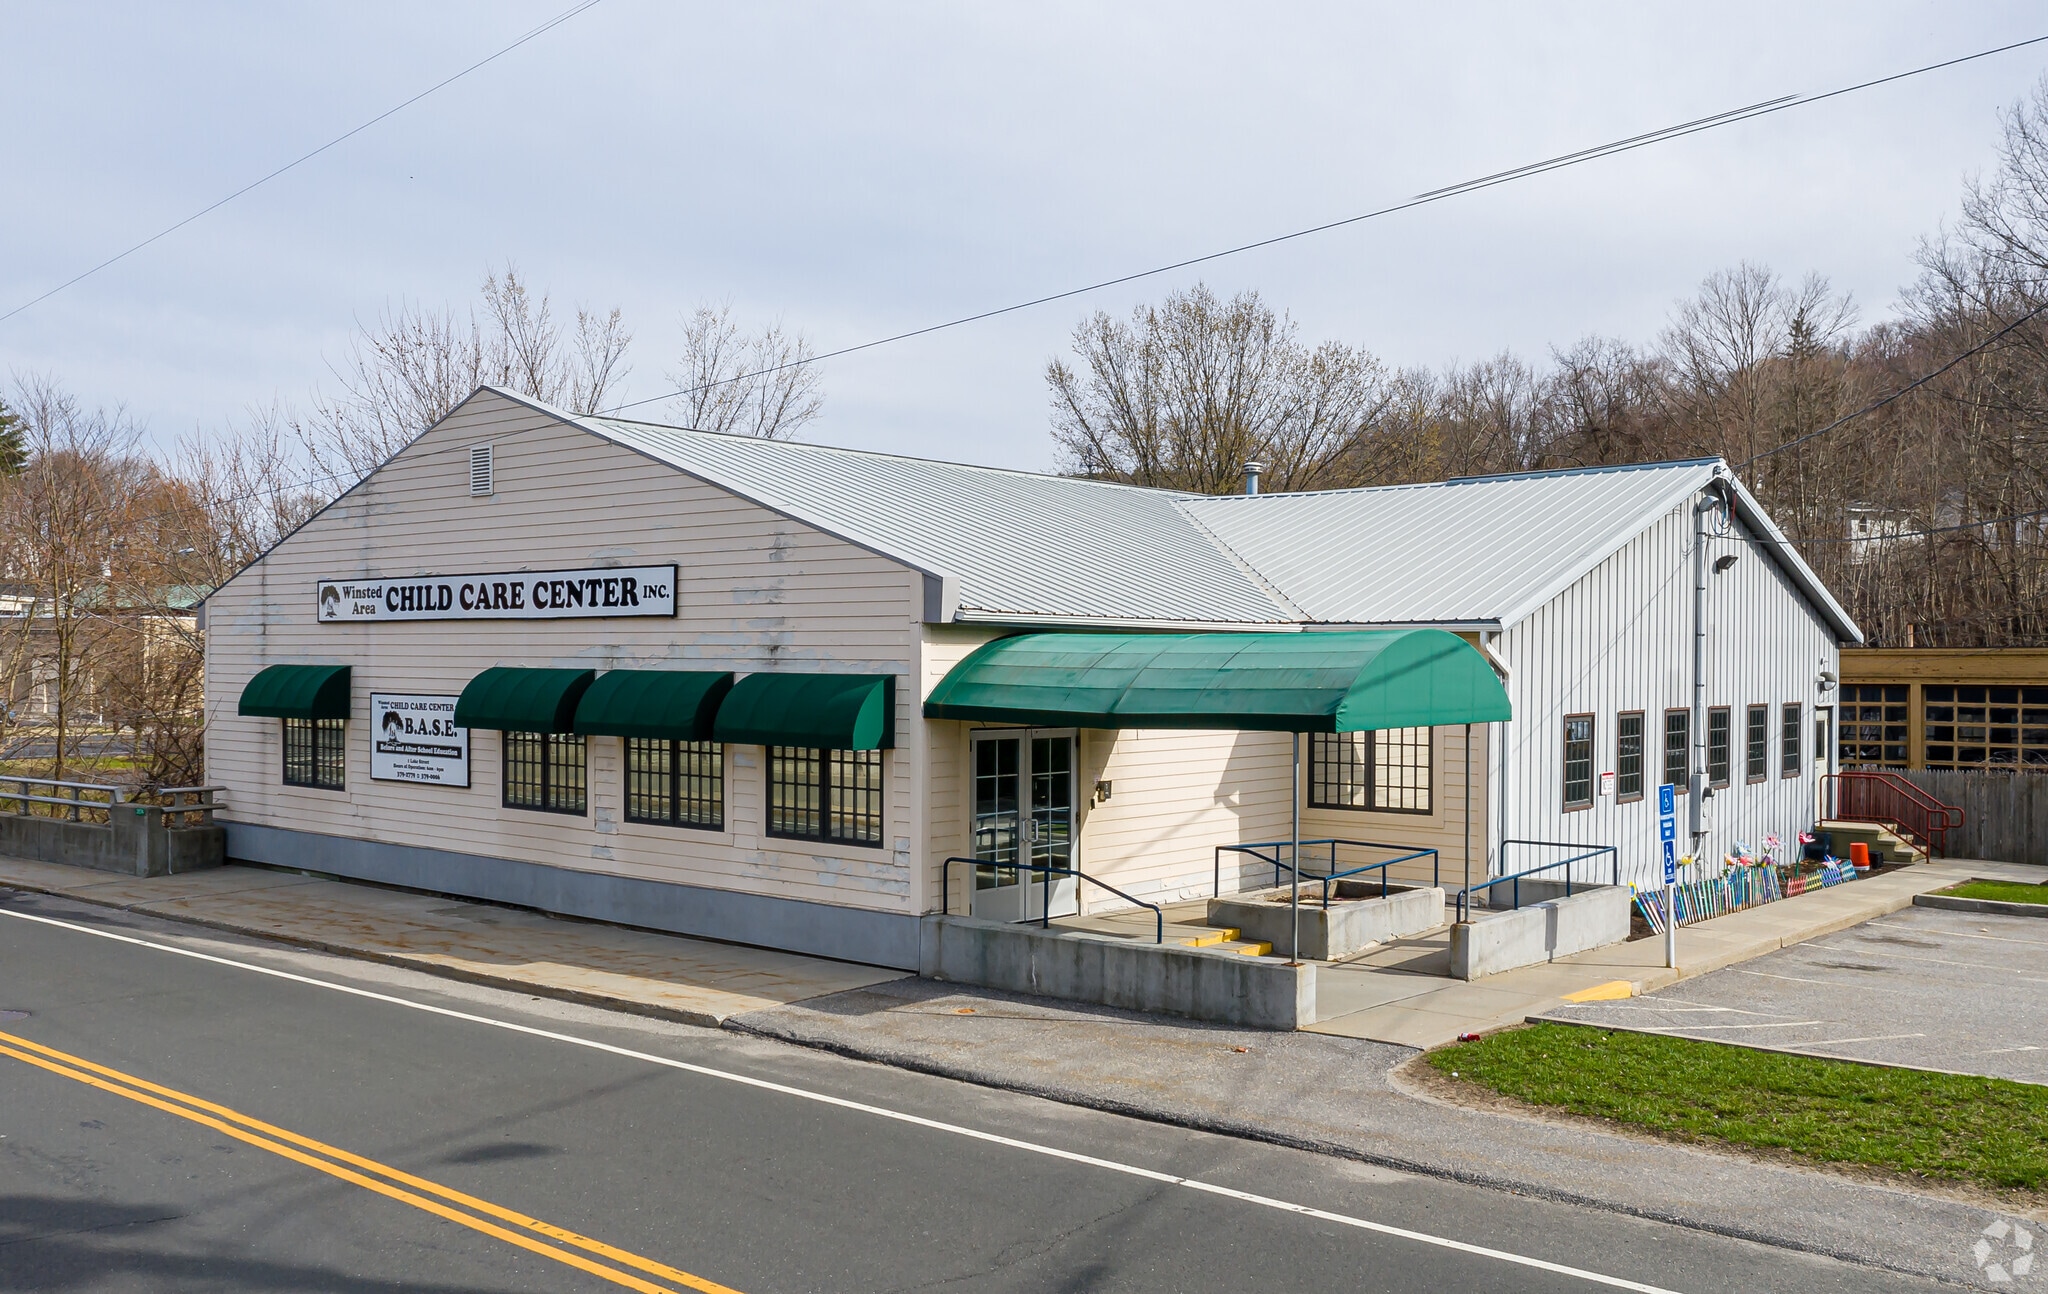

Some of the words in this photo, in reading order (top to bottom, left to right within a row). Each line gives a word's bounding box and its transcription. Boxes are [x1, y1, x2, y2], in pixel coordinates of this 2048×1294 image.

[342, 585, 383, 599] Winsted
[385, 584, 453, 612] CHILD
[459, 582, 525, 611] CARE
[532, 577, 640, 610] CENTER
[643, 585, 670, 599] INC.
[352, 601, 376, 615] Area
[390, 701, 409, 710] CHILD
[410, 702, 428, 711] CARE
[429, 703, 455, 712] CENTER
[404, 717, 458, 738] B.A.S.E.
